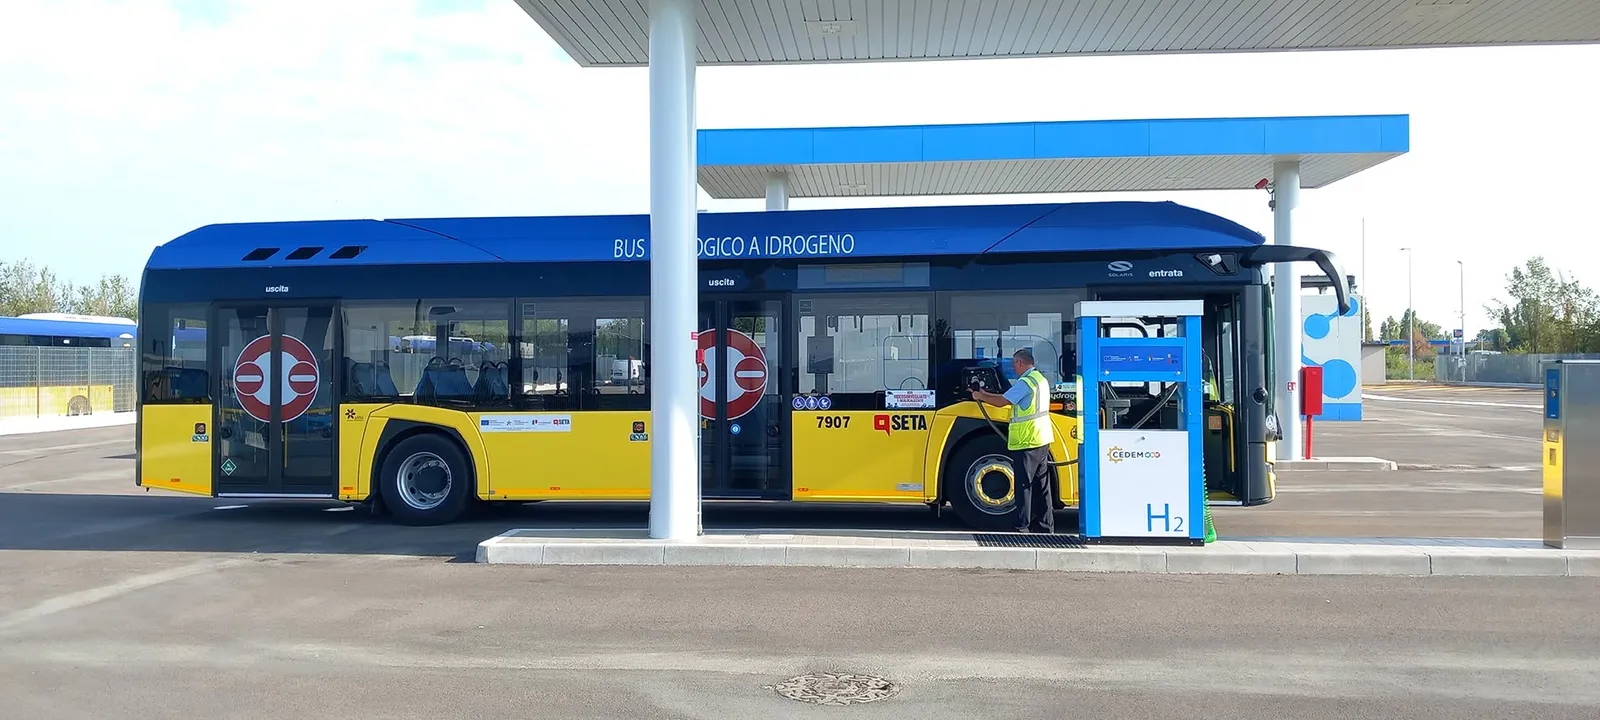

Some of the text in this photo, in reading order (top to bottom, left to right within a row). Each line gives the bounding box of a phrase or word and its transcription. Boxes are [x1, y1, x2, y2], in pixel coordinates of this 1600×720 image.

[614, 234, 855, 257] BUS OGICO A IDROGENO
[708, 278, 735, 286] uscita
[816, 416, 850, 428] 7907
[891, 415, 927, 430] SETA
[1147, 503, 1184, 532] H2
